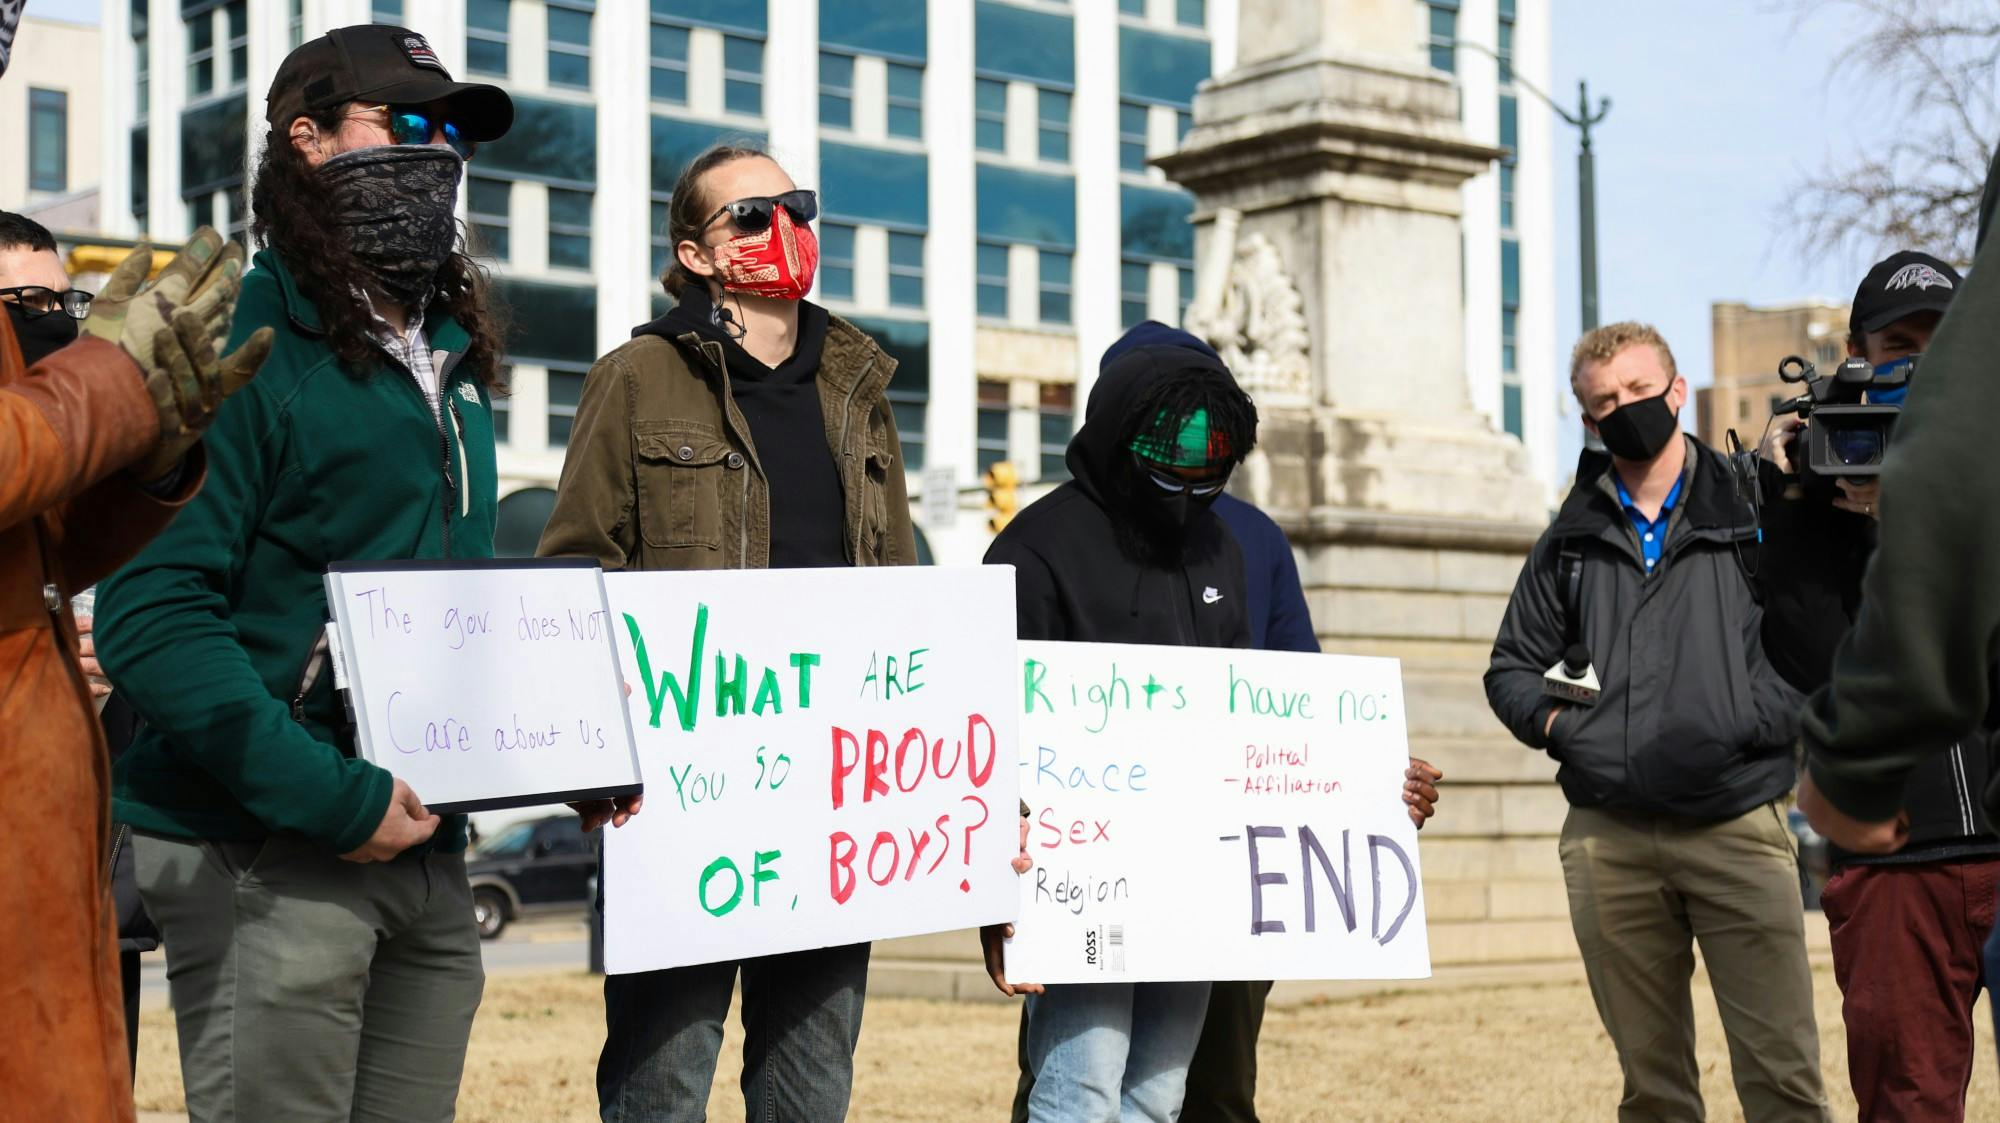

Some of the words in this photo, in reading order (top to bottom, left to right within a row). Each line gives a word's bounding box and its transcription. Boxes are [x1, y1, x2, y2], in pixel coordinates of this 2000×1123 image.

[356, 587, 412, 639] The
[444, 607, 492, 650] gov.
[518, 595, 561, 641] does
[568, 609, 606, 645] NOT
[622, 602, 820, 732] WHAT
[859, 647, 930, 702] ARE
[1023, 658, 1186, 733] Rights
[1229, 663, 1314, 720] have
[1339, 689, 1388, 724] no:
[387, 691, 473, 754] Care
[495, 713, 563, 751] about
[669, 763, 725, 811] YOU
[831, 713, 997, 810] PROUD
[828, 795, 989, 905] BOYS?
[1039, 807, 1111, 849] Sex
[1085, 931, 1096, 964] ROSS
